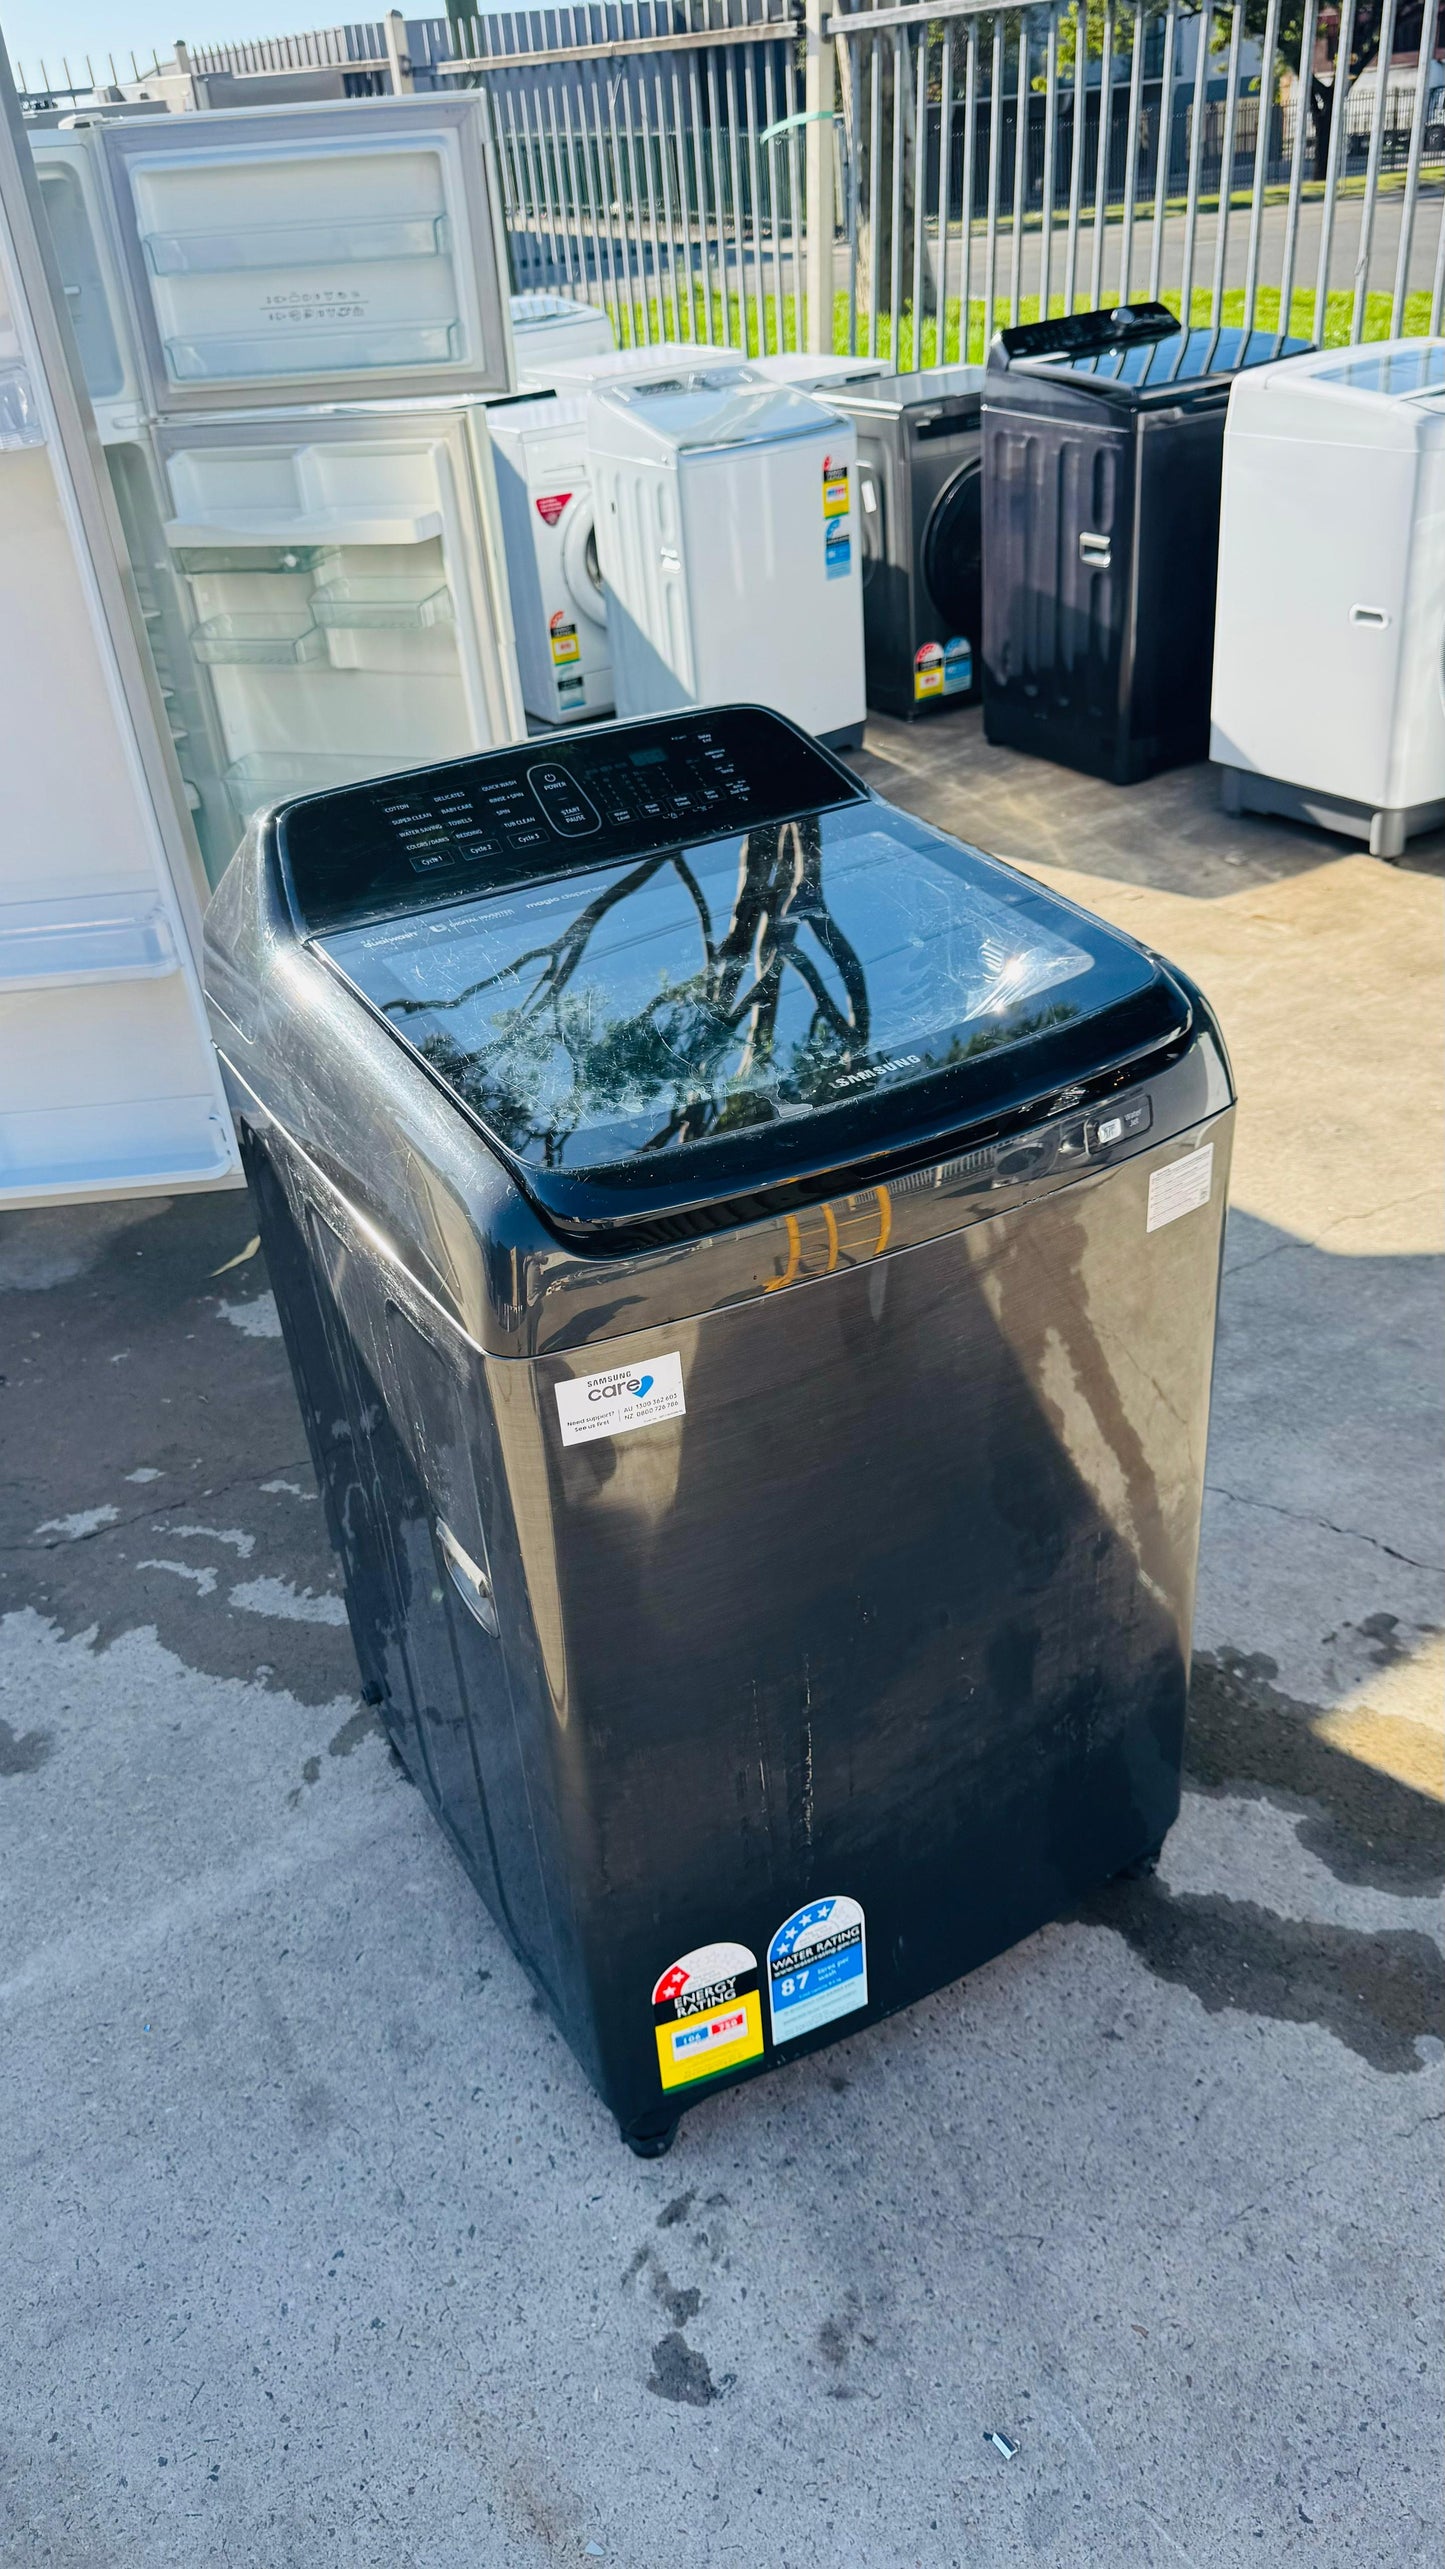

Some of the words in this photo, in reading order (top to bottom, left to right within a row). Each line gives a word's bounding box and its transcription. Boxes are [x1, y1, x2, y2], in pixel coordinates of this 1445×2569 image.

[482, 784, 499, 792] QUICK
[499, 780, 517, 789] WASH
[544, 782, 567, 790] POWER
[434, 792, 465, 802] DELICATES
[385, 804, 409, 813] COTTON
[441, 806, 457, 814] BABY
[458, 803, 473, 811] CARE
[561, 806, 580, 815] START
[392, 817, 411, 826] SUPER
[412, 813, 432, 821] CLEAN
[448, 817, 473, 827] TOWELS
[516, 817, 535, 826] CLEAN
[566, 815, 586, 823] PAUSE
[399, 829, 419, 838] WATER
[420, 824, 442, 834] SAVING
[456, 829, 483, 839] BEDDING
[518, 835, 534, 843] Cycle
[470, 845, 486, 854] Cycle
[422, 857, 438, 866] Cycle
[835, 1055, 921, 1087] SAMSUNG
[588, 1371, 632, 1388] SAMSUNG
[588, 1379, 640, 1401] care
[567, 1417, 585, 1426] Need
[586, 1411, 615, 1423] support?
[773, 1947, 814, 1971] WATER
[816, 1927, 860, 1953] RATING
[781, 1971, 810, 1997] 87
[674, 1977, 736, 2009] ENERGY
[677, 1988, 736, 2018] RATING
